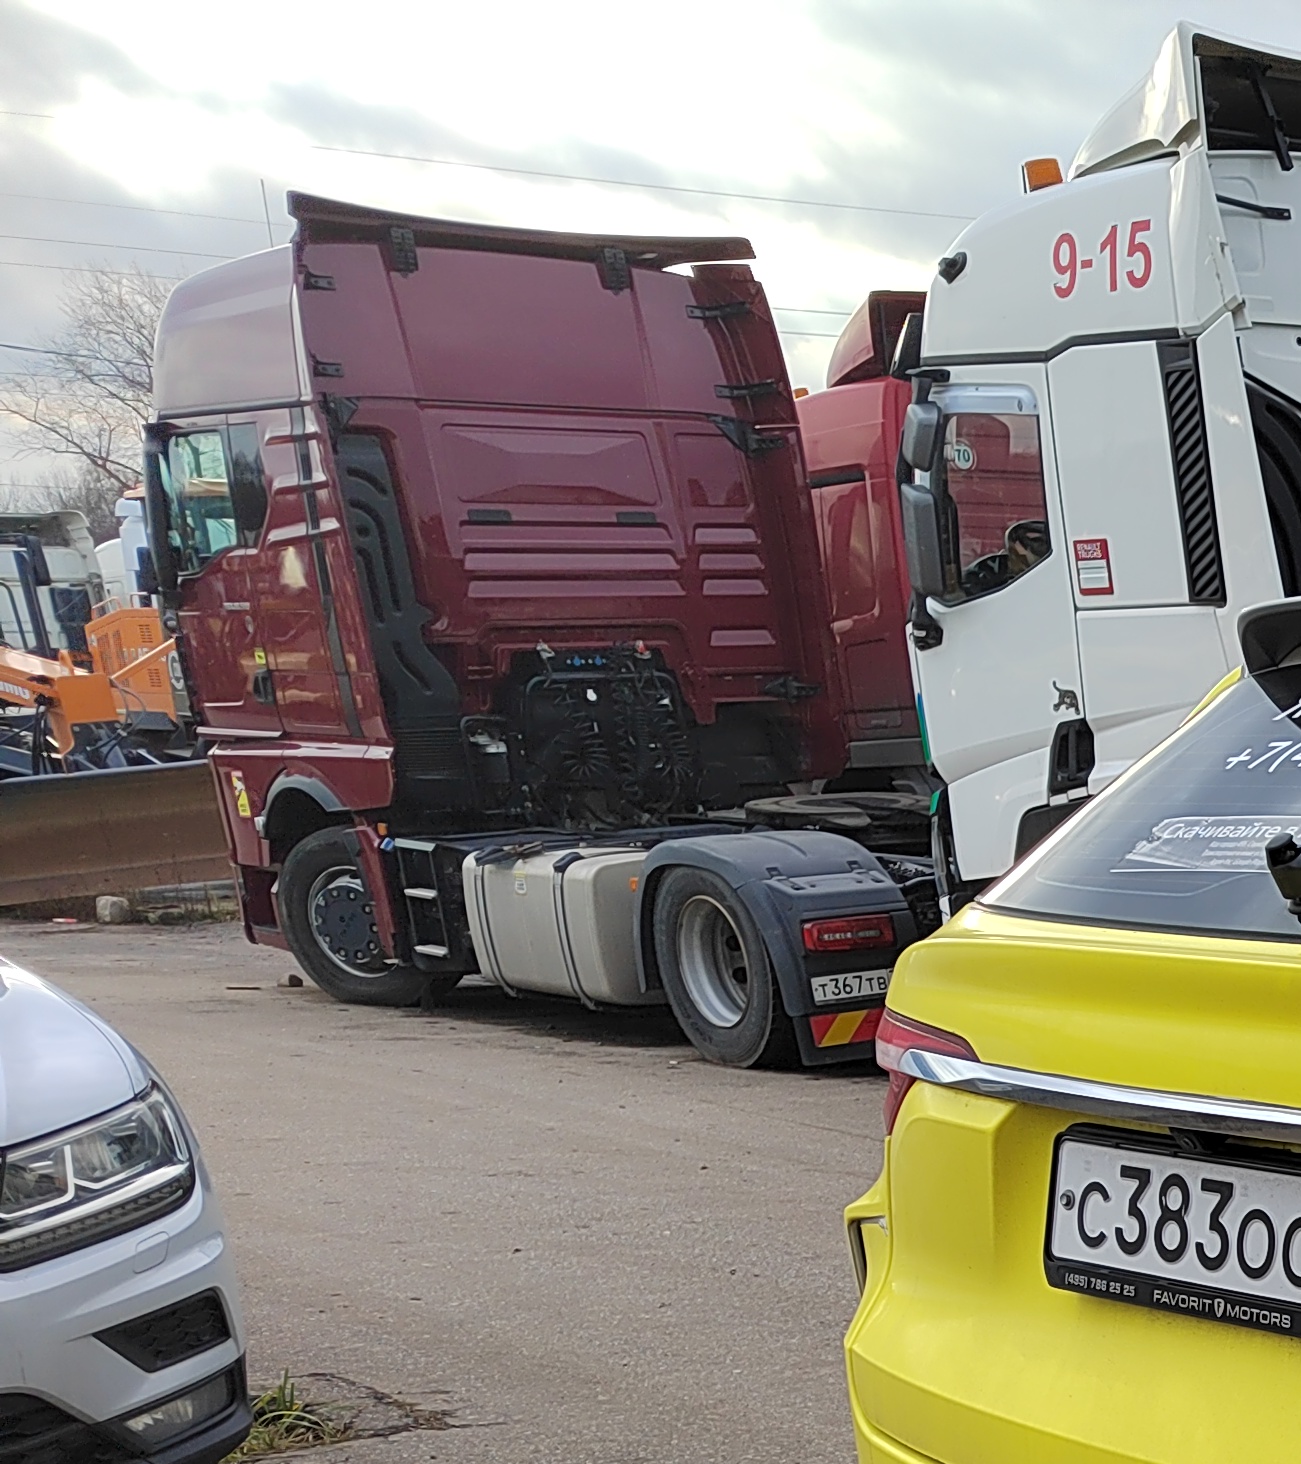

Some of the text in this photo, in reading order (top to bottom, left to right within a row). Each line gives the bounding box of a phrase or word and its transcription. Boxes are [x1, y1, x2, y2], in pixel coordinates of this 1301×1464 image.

[1053, 219, 1152, 299] 9-15
[1163, 822, 1282, 839] Скачивайте
[1065, 1272, 1088, 1289] (495)
[1108, 1282, 1121, 1294] 25
[1123, 1285, 1136, 1297] 25
[1153, 1289, 1213, 1313] FAVORIT
[1226, 1303, 1292, 1329] MOTORS
